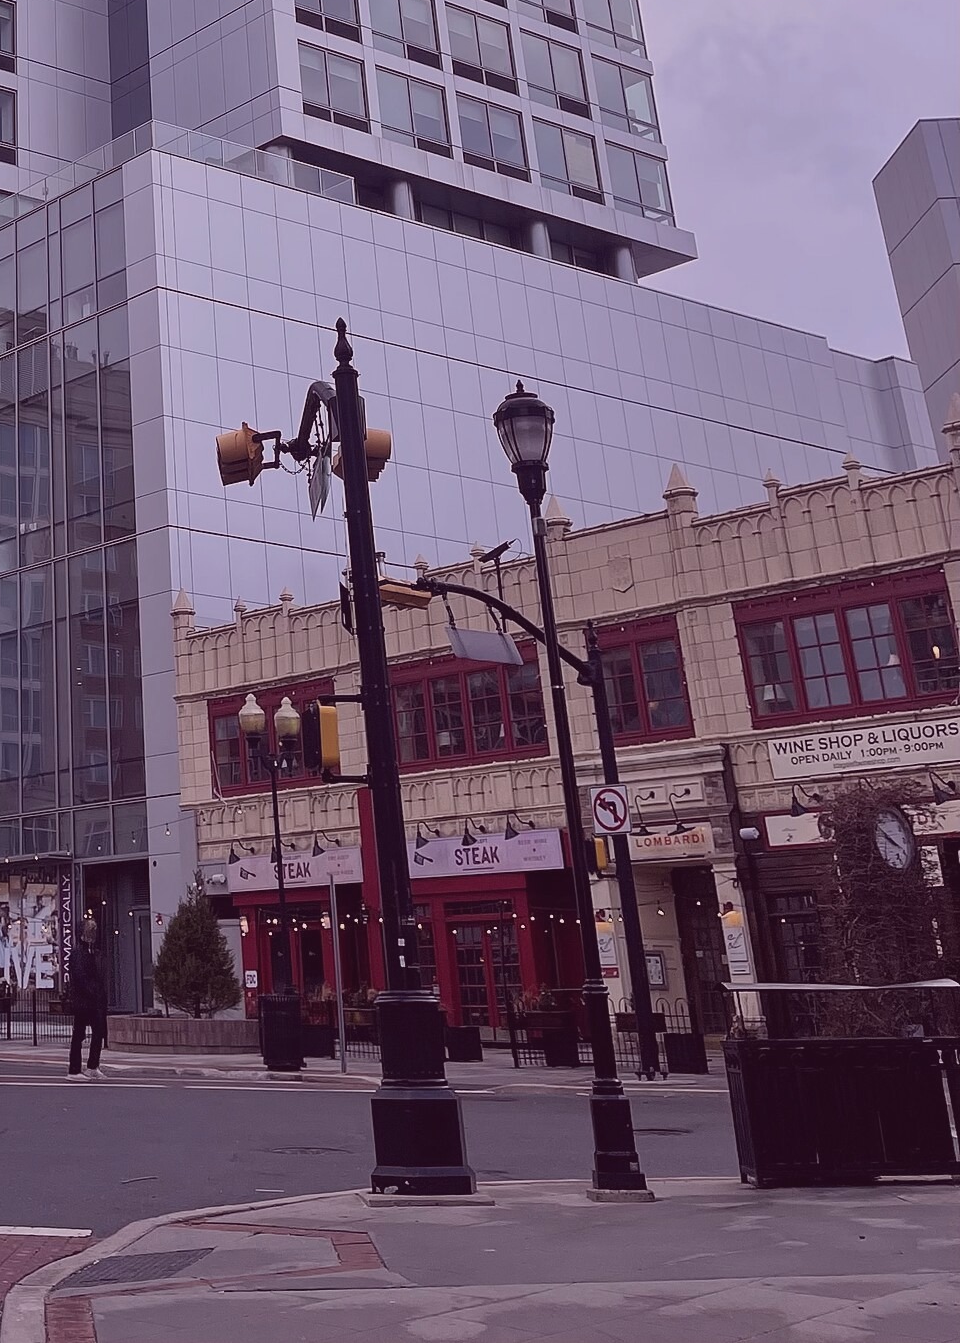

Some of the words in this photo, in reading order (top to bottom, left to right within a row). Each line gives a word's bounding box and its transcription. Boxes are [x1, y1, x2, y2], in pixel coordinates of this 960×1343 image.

[773, 739, 815, 755] WINE
[818, 734, 863, 750] SHOP
[867, 732, 879, 744] &
[882, 722, 959, 743] LIQUORS
[791, 754, 820, 765] OPEN
[822, 750, 852, 762] DAILY
[860, 747, 898, 758] 1:00PM
[903, 742, 944, 753] 9:00PM
[636, 834, 705, 848] LOMBARDI
[454, 846, 500, 866] STEAK
[273, 862, 311, 880] STEAK
